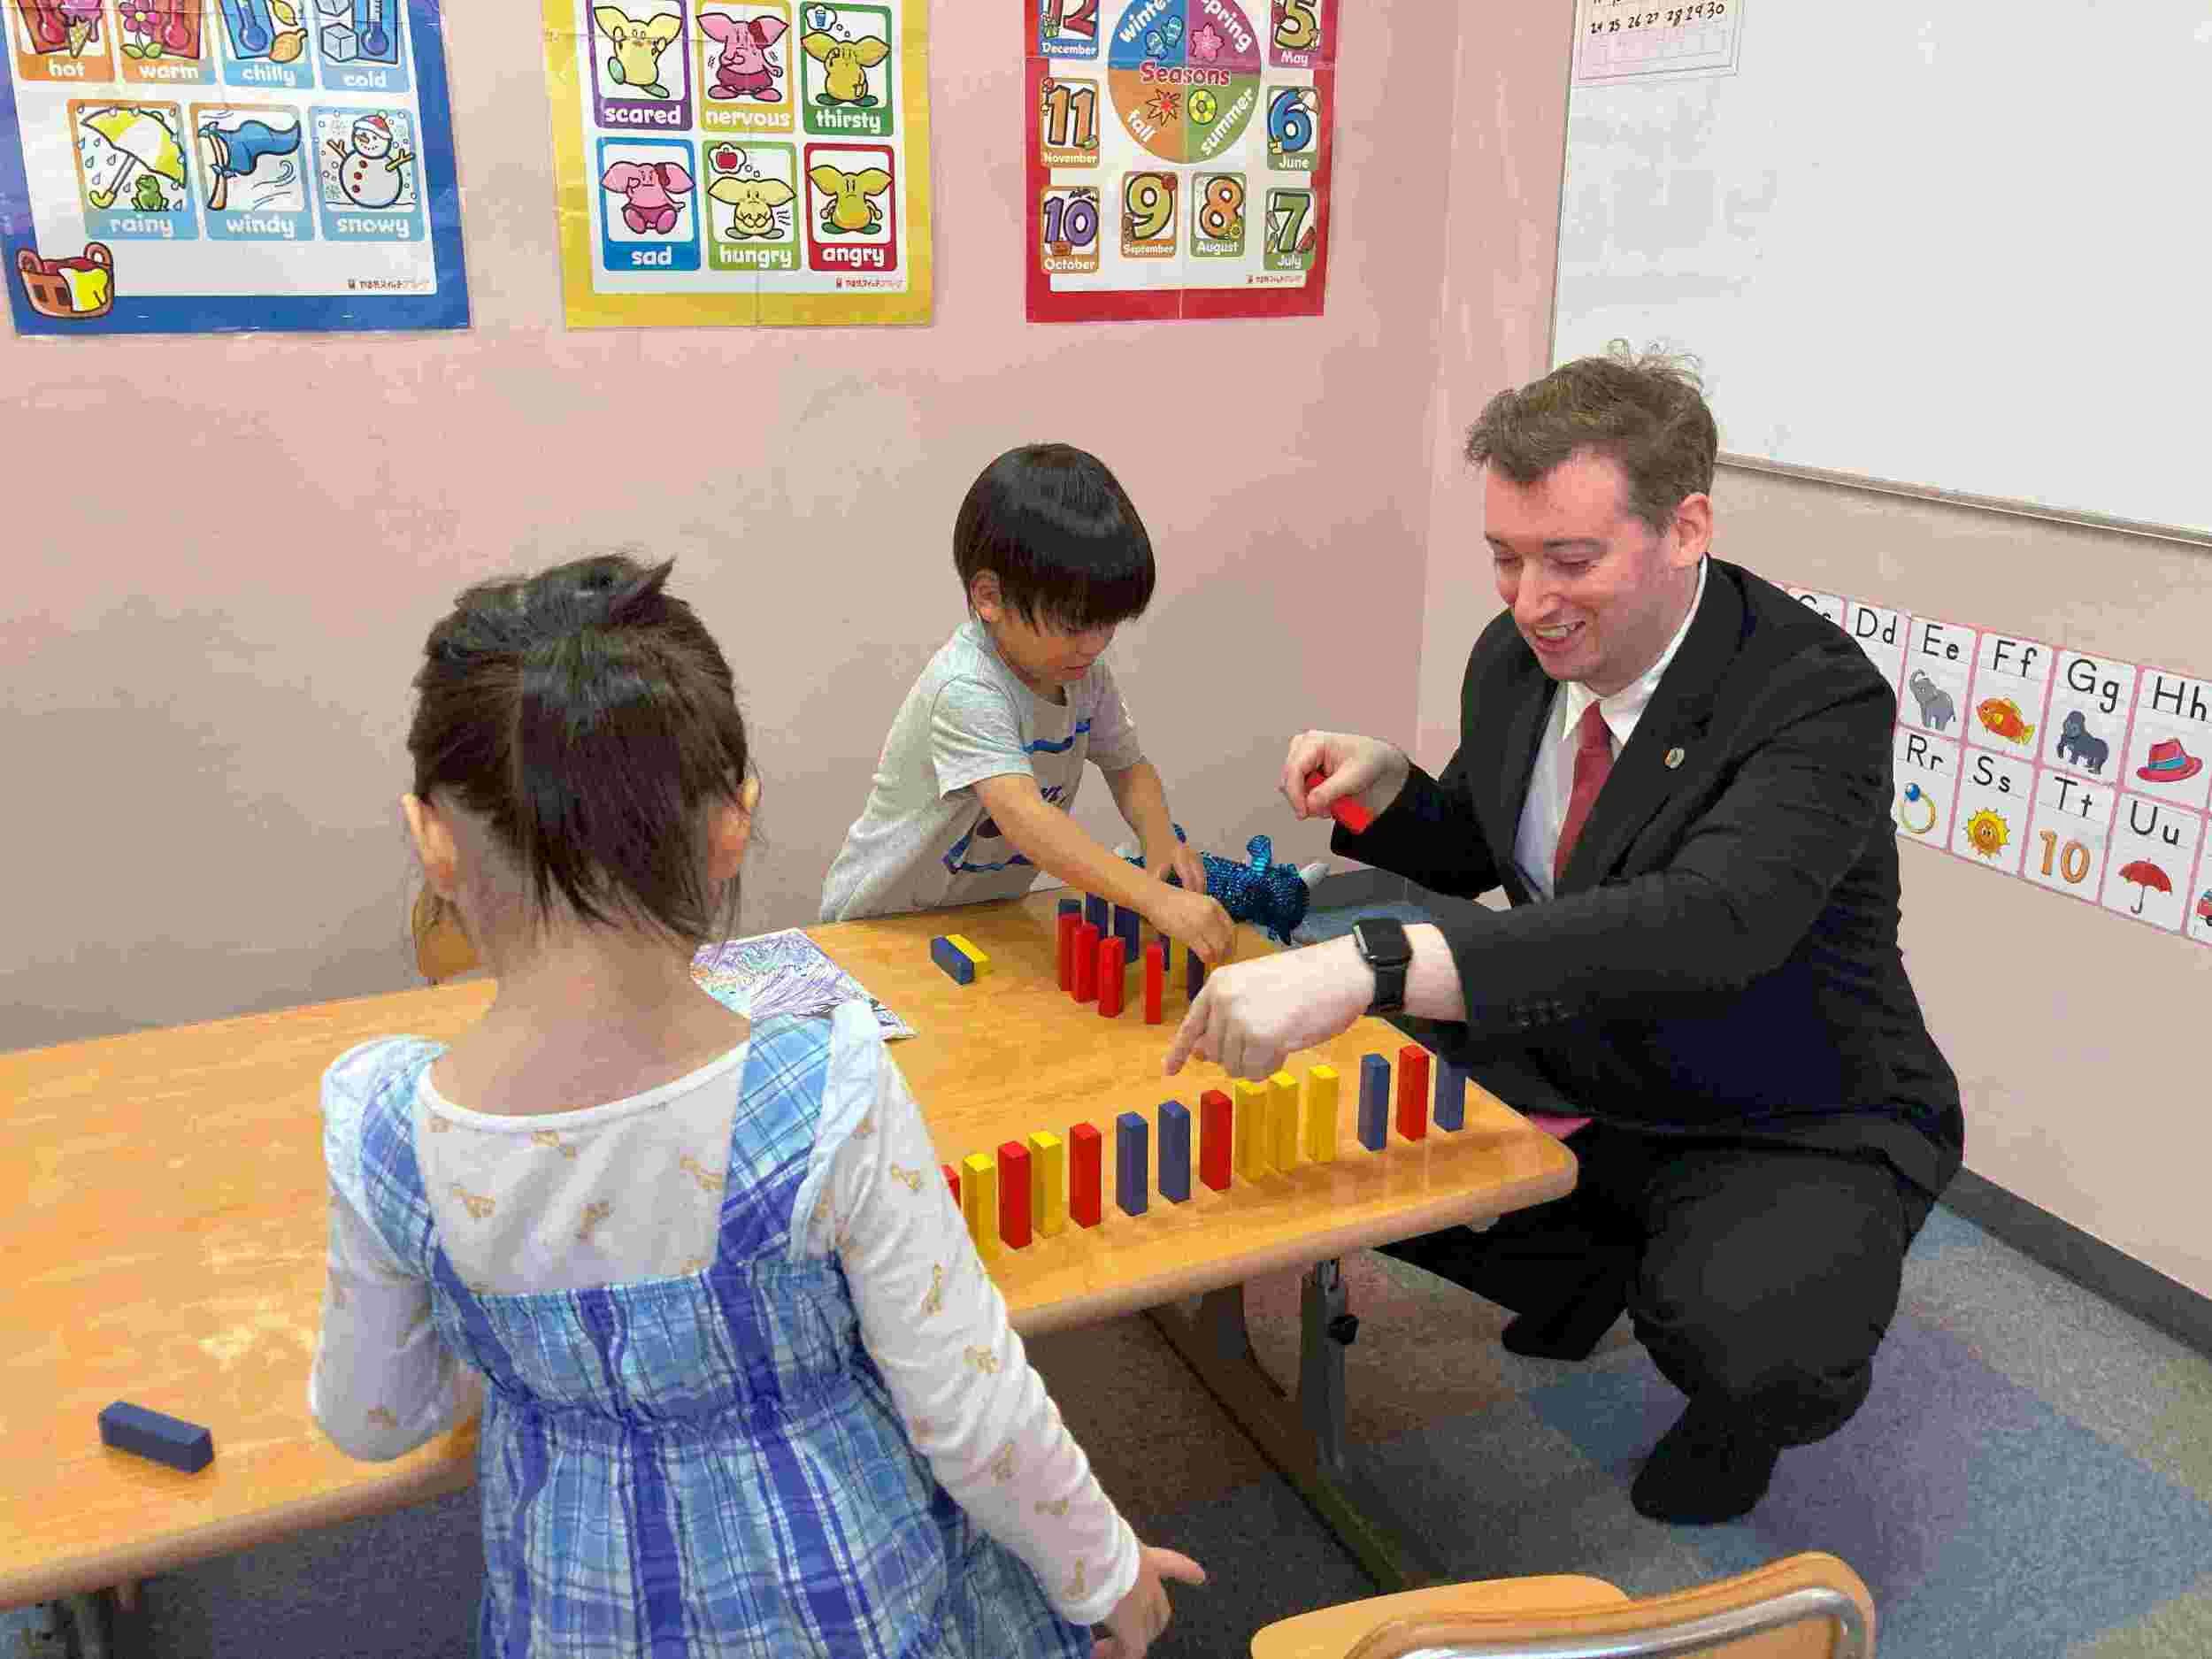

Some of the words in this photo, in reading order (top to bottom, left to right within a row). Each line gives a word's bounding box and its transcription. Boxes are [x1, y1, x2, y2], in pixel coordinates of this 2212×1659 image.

[1118, 0, 1171, 42] winte
[1202, 0, 1252, 54] pring
[1274, 0, 1317, 50] 5
[1591, 21, 1602, 34] 24
[1609, 19, 1621, 32] 25
[1628, 14, 1641, 28] 26
[1646, 12, 1659, 24] 27
[1667, 9, 1682, 27] 28
[1685, 4, 1703, 20] 29
[1707, 2, 1725, 19] 30
[1041, 42, 1096, 55] December
[1281, 50, 1309, 66] May
[50, 60, 85, 78] hot
[139, 63, 199, 80] warm
[242, 60, 296, 87] chilly
[344, 70, 387, 88] cold
[1140, 61, 1232, 86] Seasons
[603, 105, 681, 126] scared
[705, 109, 790, 128] nervous
[816, 110, 881, 132] thirsty
[1047, 85, 1094, 147] 11
[1127, 109, 1157, 142] fall
[1201, 88, 1253, 156] summer
[1268, 88, 1312, 152] 6
[1041, 152, 1097, 164] November
[1279, 156, 1310, 168] June
[1126, 173, 1172, 240] 9
[1201, 176, 1243, 240] 8
[111, 216, 174, 237] rainy
[226, 215, 296, 238] windy
[337, 216, 410, 237] snowy
[1044, 196, 1099, 247] 10
[1274, 192, 1310, 253] 7
[631, 245, 672, 265] sad
[719, 244, 793, 268] hungry
[822, 247, 885, 267] angry
[1197, 242, 1239, 255] August
[1044, 258, 1095, 270] October
[1277, 255, 1302, 269] July
[2039, 829, 2091, 884] 10
